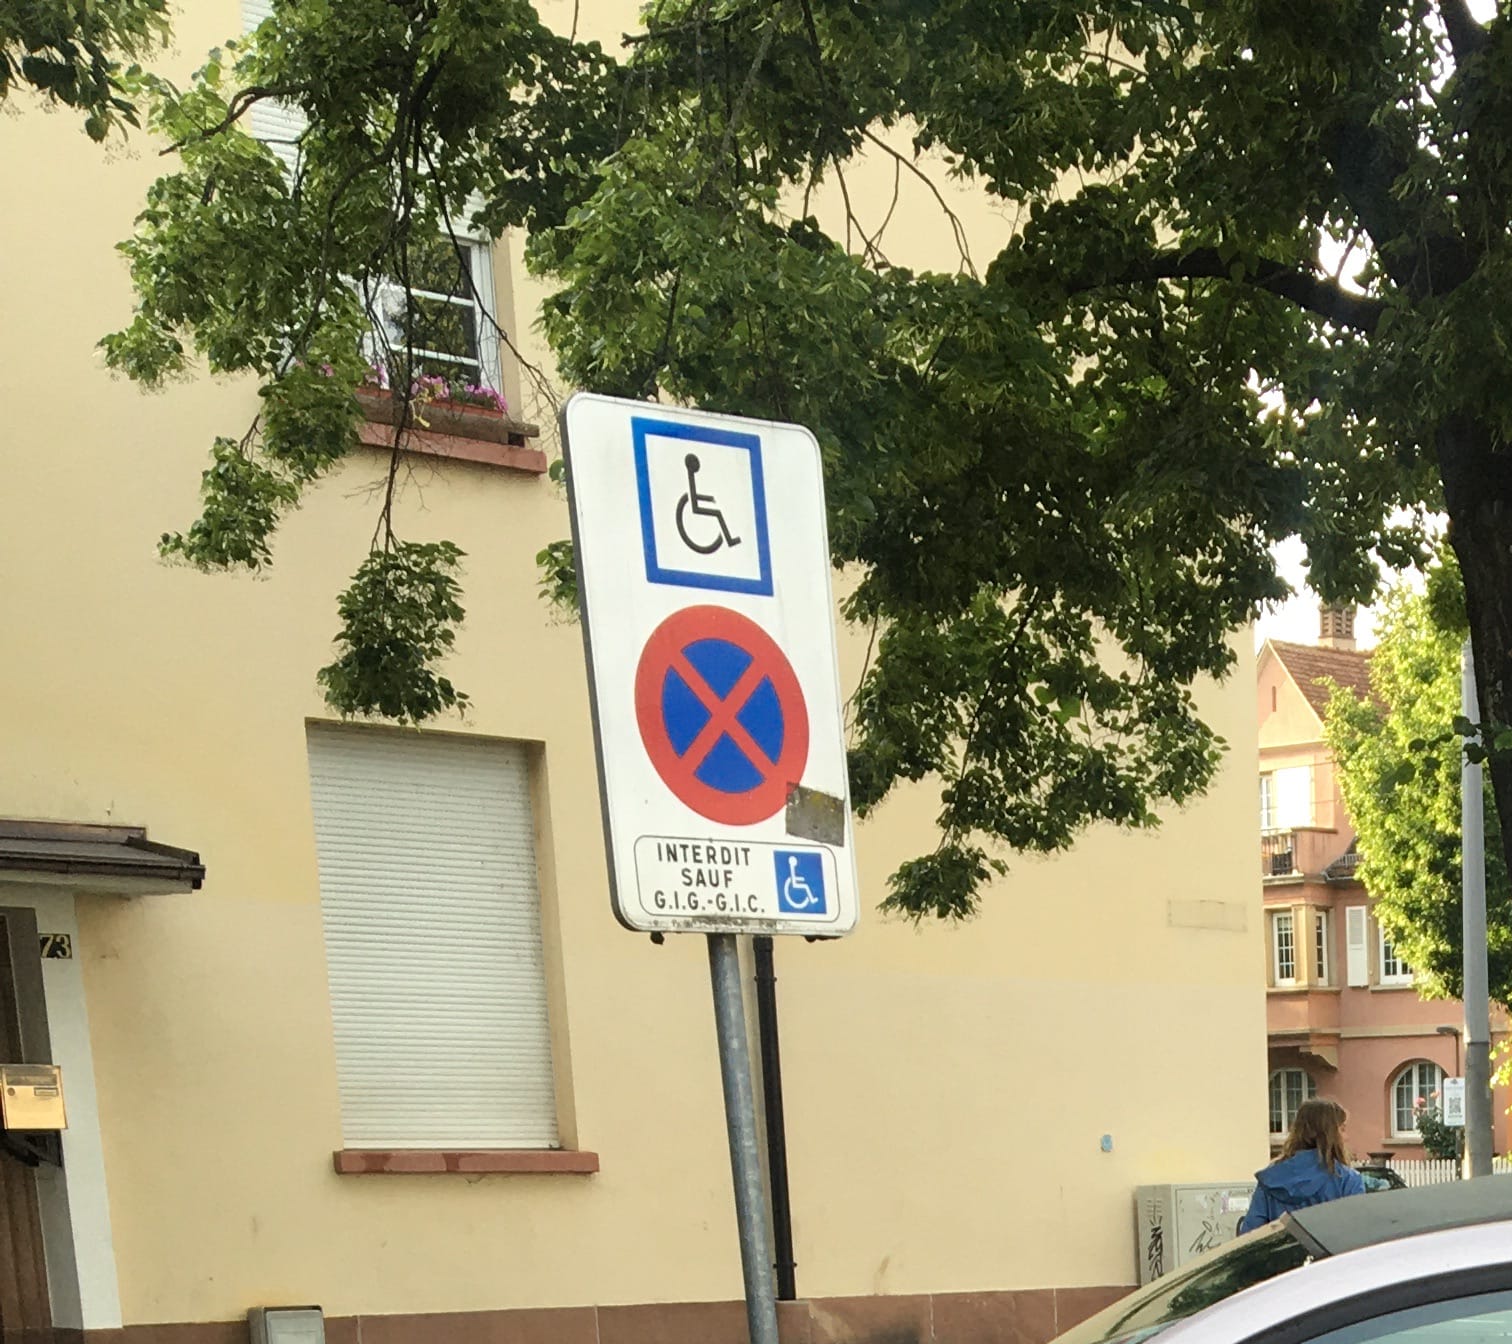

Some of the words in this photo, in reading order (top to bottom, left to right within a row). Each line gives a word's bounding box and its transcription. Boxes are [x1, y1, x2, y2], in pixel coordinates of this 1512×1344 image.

[657, 842, 751, 866] INTERDIT
[681, 868, 733, 888] SAUF
[654, 890, 766, 914] G.I.G.-G.I.C.
[40, 935, 71, 958] 73
